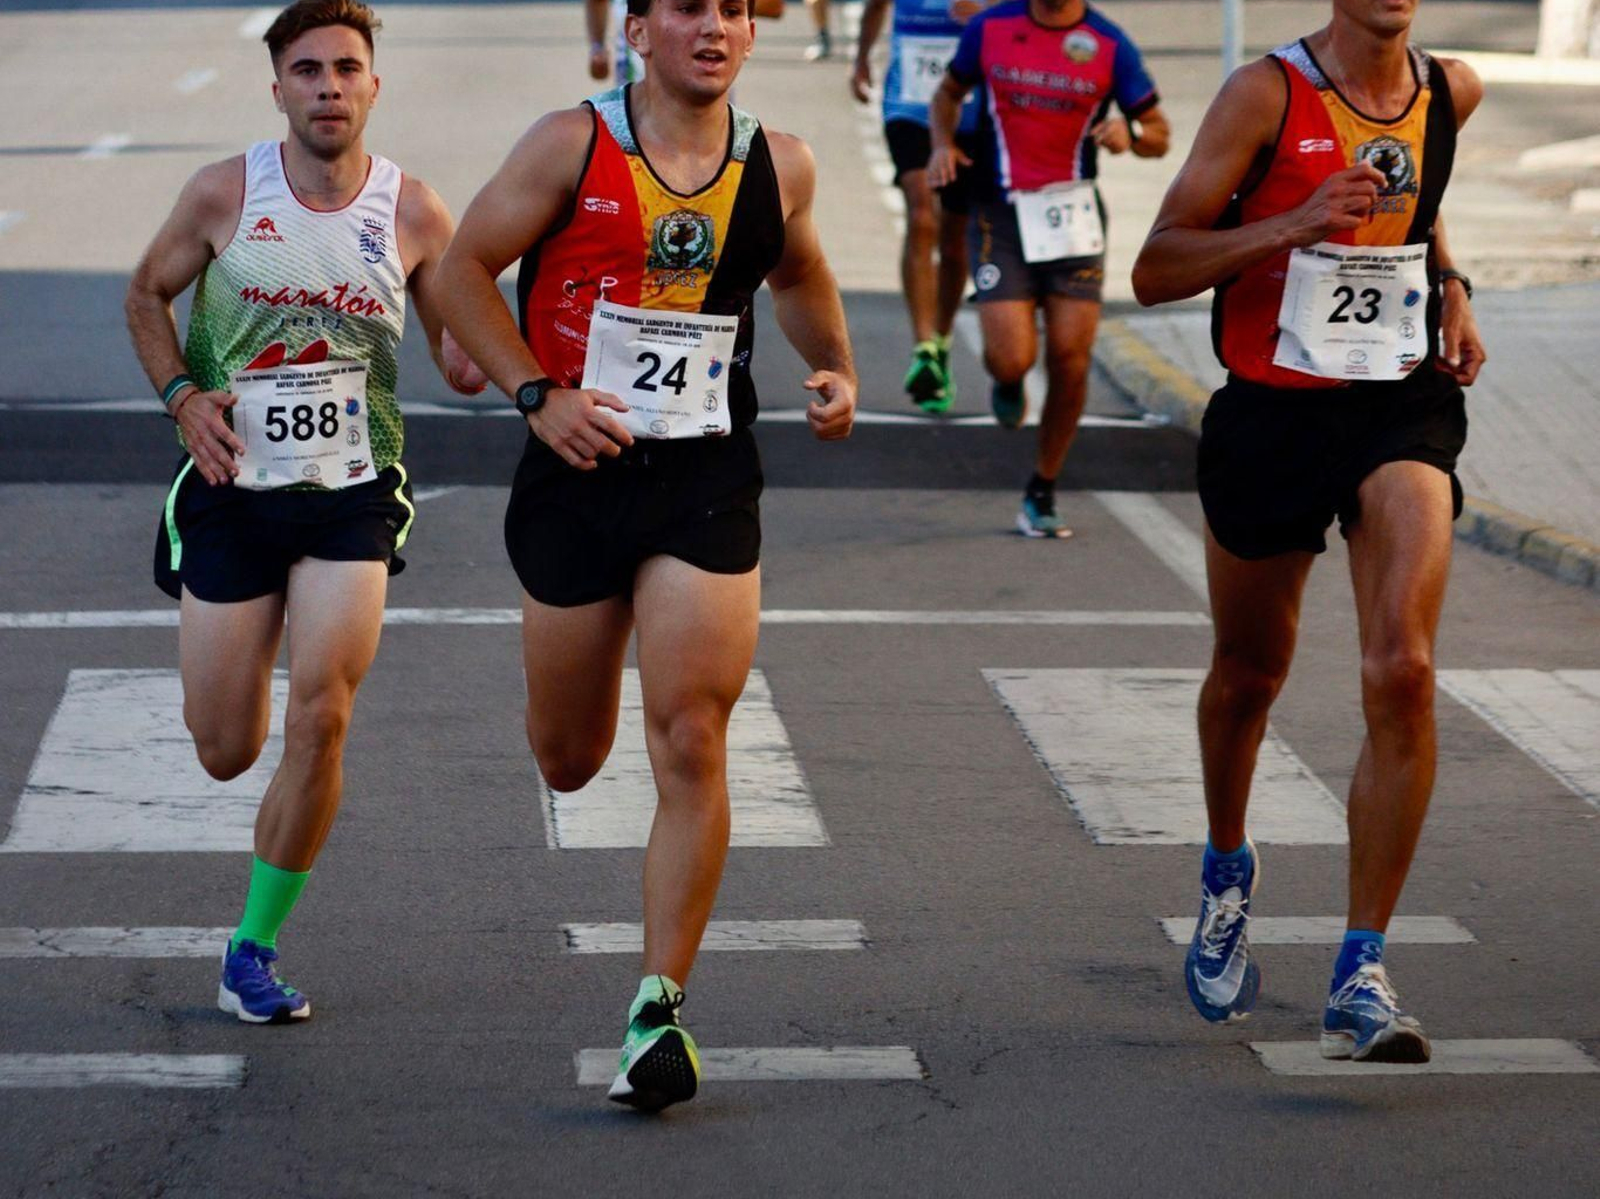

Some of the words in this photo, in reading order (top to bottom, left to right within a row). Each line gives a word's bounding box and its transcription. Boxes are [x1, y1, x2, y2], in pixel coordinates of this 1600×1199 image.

[1045, 204, 1074, 229] 97
[240, 281, 386, 317] maratón
[1327, 285, 1382, 324] 23
[279, 316, 343, 330] JEREZ
[632, 351, 688, 395] 24
[265, 401, 339, 442] 588
